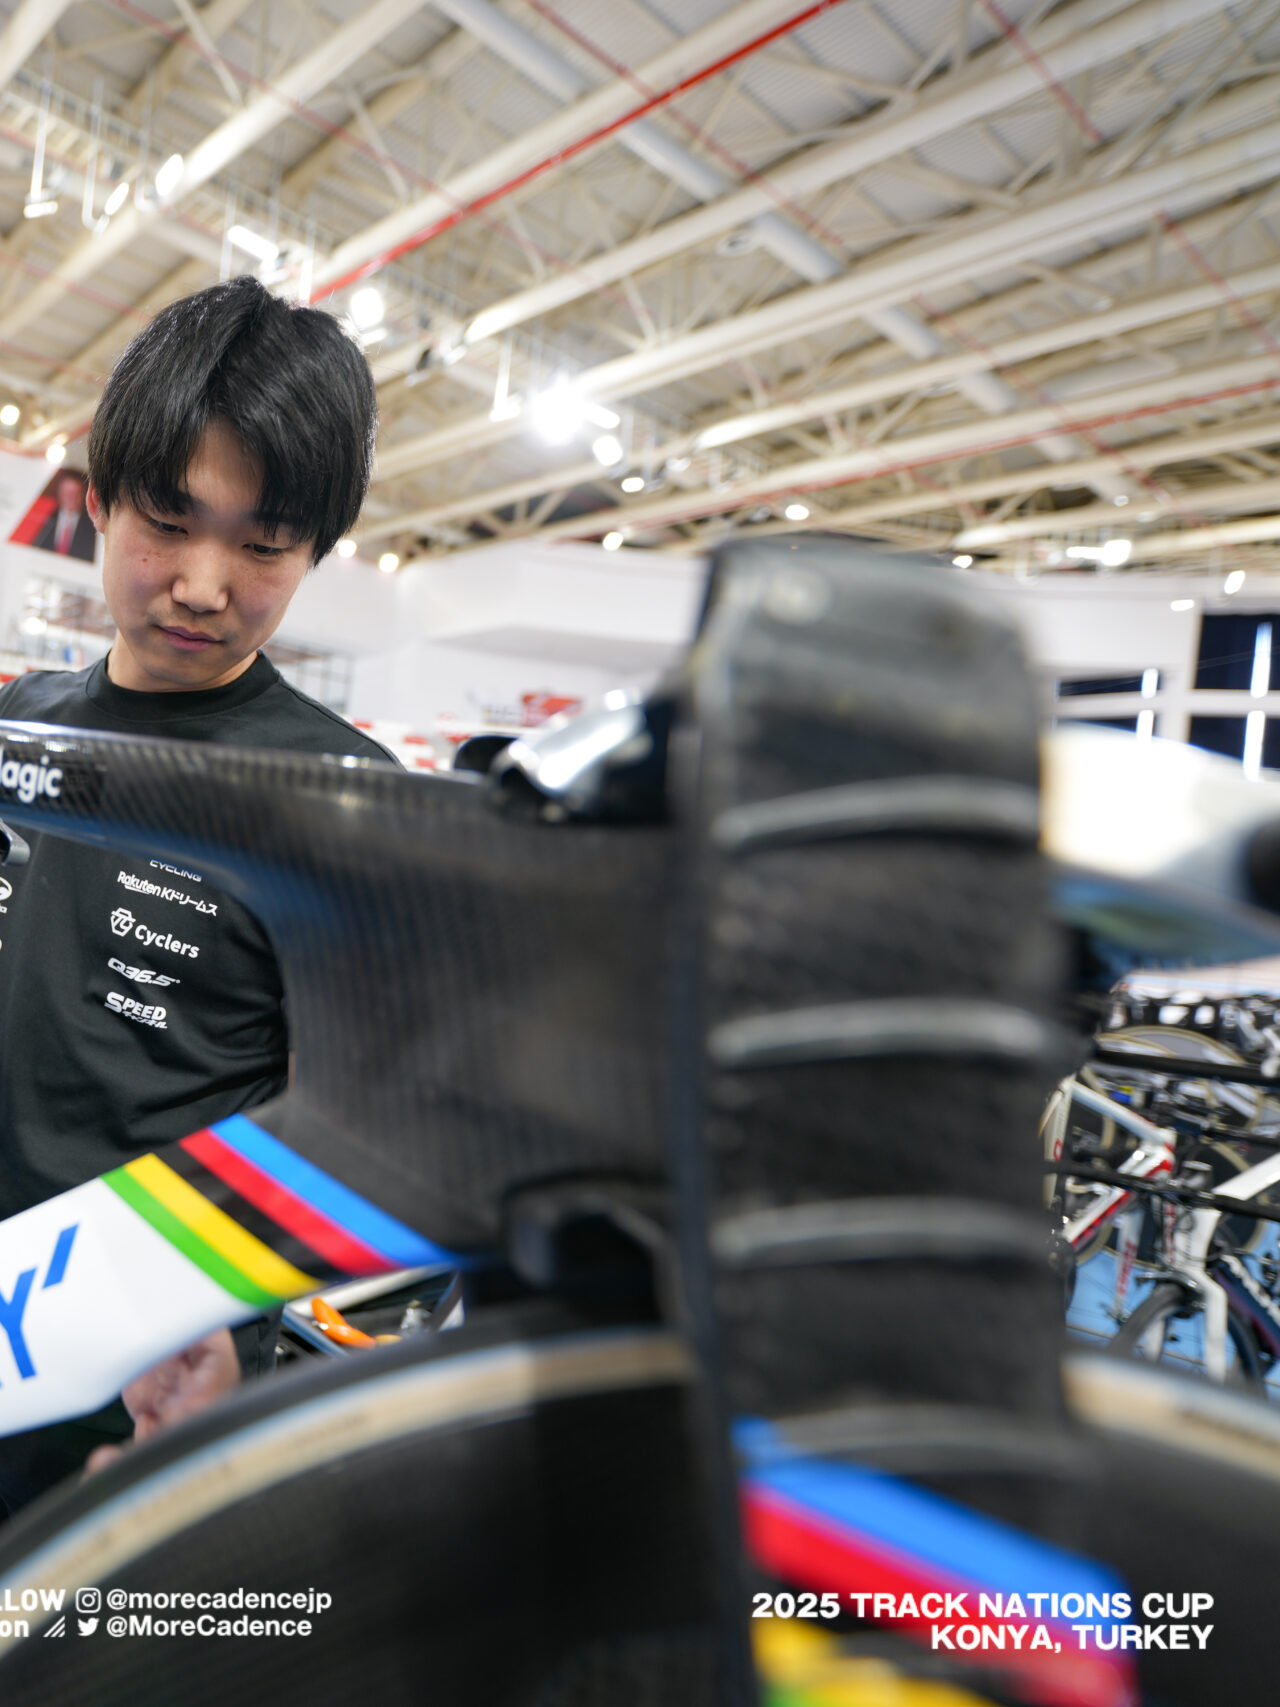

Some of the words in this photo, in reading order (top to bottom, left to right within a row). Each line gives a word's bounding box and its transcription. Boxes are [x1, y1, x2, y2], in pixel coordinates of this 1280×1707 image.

[149, 859, 203, 882] CYCLING
[134, 924, 200, 959] Cyclers
[104, 991, 167, 1021] SPEED
